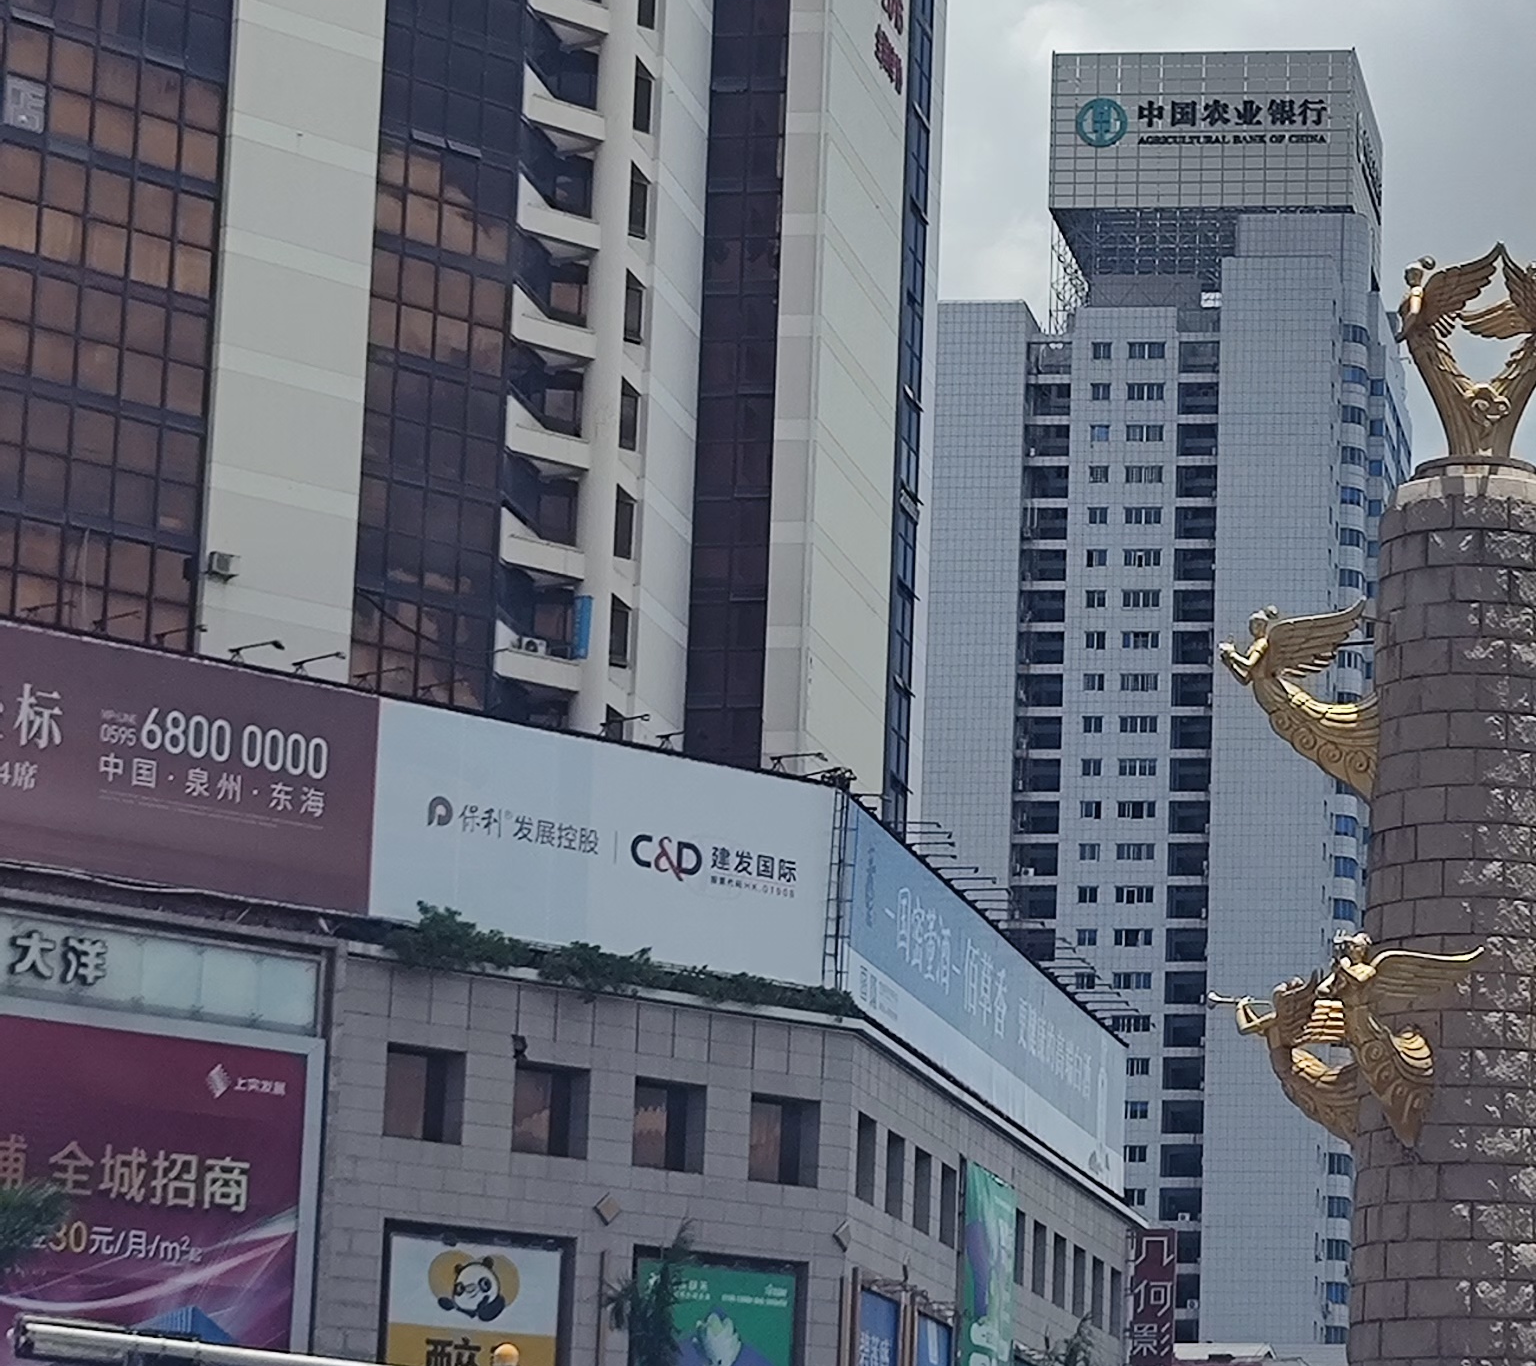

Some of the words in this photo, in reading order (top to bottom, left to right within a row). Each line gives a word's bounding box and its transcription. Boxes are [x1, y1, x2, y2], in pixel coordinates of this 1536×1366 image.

[1137, 98, 1328, 128] 中国农业银行
[1137, 134, 1231, 146] AGRICULTURAL
[1232, 134, 1267, 146] BANK
[1269, 134, 1286, 146] OF
[1287, 134, 1328, 146] CHINA
[13, 683, 63, 750] 标
[100, 723, 138, 747] 0595
[140, 707, 232, 763] 6800
[241, 724, 329, 780] 0000
[630, 833, 703, 882] C&D
[710, 846, 797, 884] 建发国际
[10, 930, 107, 986] 大洋
[49, 1139, 251, 1213] 全城招商
